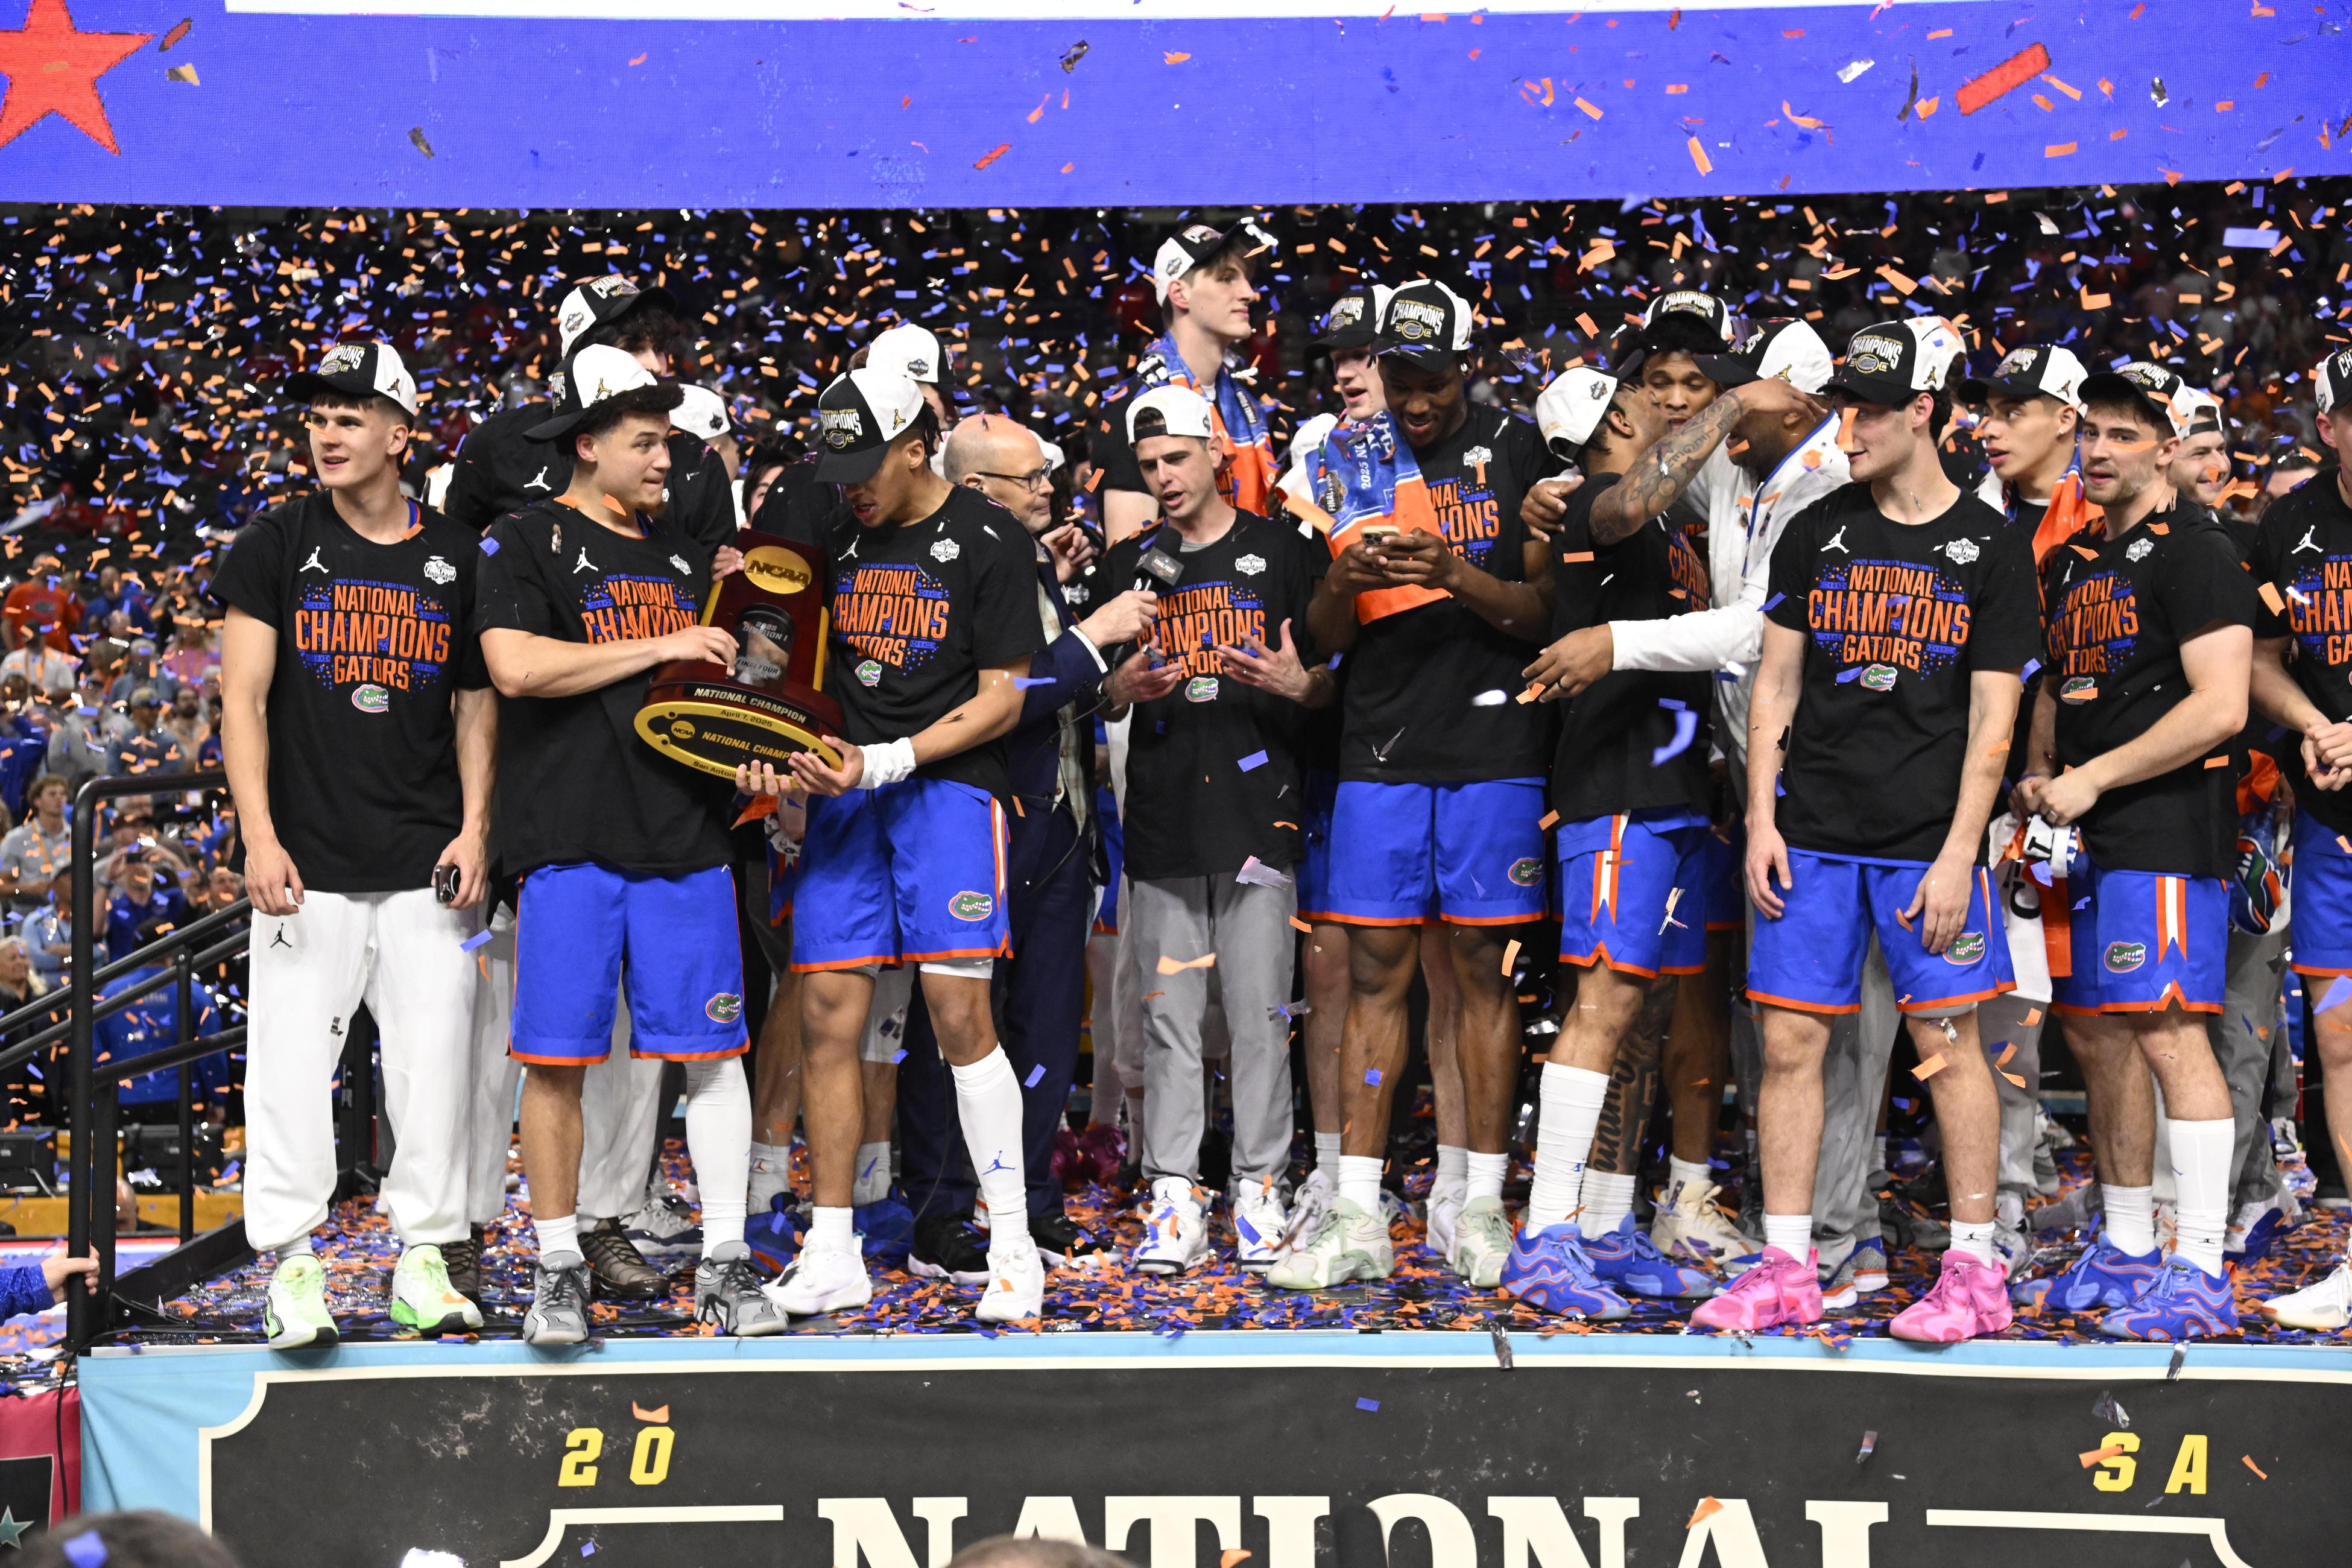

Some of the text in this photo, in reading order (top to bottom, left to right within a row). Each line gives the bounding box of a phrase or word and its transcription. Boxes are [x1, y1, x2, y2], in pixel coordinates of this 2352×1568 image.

[1390, 303, 1444, 335] CHAMPIONS
[1661, 294, 1715, 318] CHAMPIONS
[320, 347, 365, 373] AMPIONS
[1847, 339, 1903, 370] CHAMPIONS
[1355, 441, 1372, 490] 2025 NC
[1326, 491, 1336, 511] FINAL
[440, 567, 456, 577] FOUR
[749, 560, 808, 587] NCAA
[1849, 565, 1934, 598] NATIONAL
[1901, 561, 1934, 572] BASKETBALL
[383, 581, 414, 592] BASKETBALL
[853, 569, 917, 596] NATIONAL
[334, 585, 417, 618] NATIONAL
[833, 593, 949, 639] CHAMPIONS
[1157, 586, 1233, 620] NATIONAL
[1809, 589, 1971, 645] CHAMPIONS
[296, 609, 450, 662] CHAMPIONS
[581, 604, 697, 645] CHAMPIO
[1137, 609, 1266, 657] AMPIONS
[1166, 650, 1224, 681] ATOR
[1843, 634, 1922, 670] GATORS
[2063, 644, 2108, 675] TORS
[334, 654, 409, 691] GATORS
[758, 665, 779, 674] FOUR
[694, 688, 806, 724] NATIONAL CHAMPION
[721, 710, 740, 718] April
[750, 716, 773, 727] 2025
[673, 727, 694, 736] NCAA
[701, 731, 791, 760] NATIONAL CHAMP
[694, 761, 736, 779] San Antoni
[818, 1493, 1889, 1568] NTINAL
